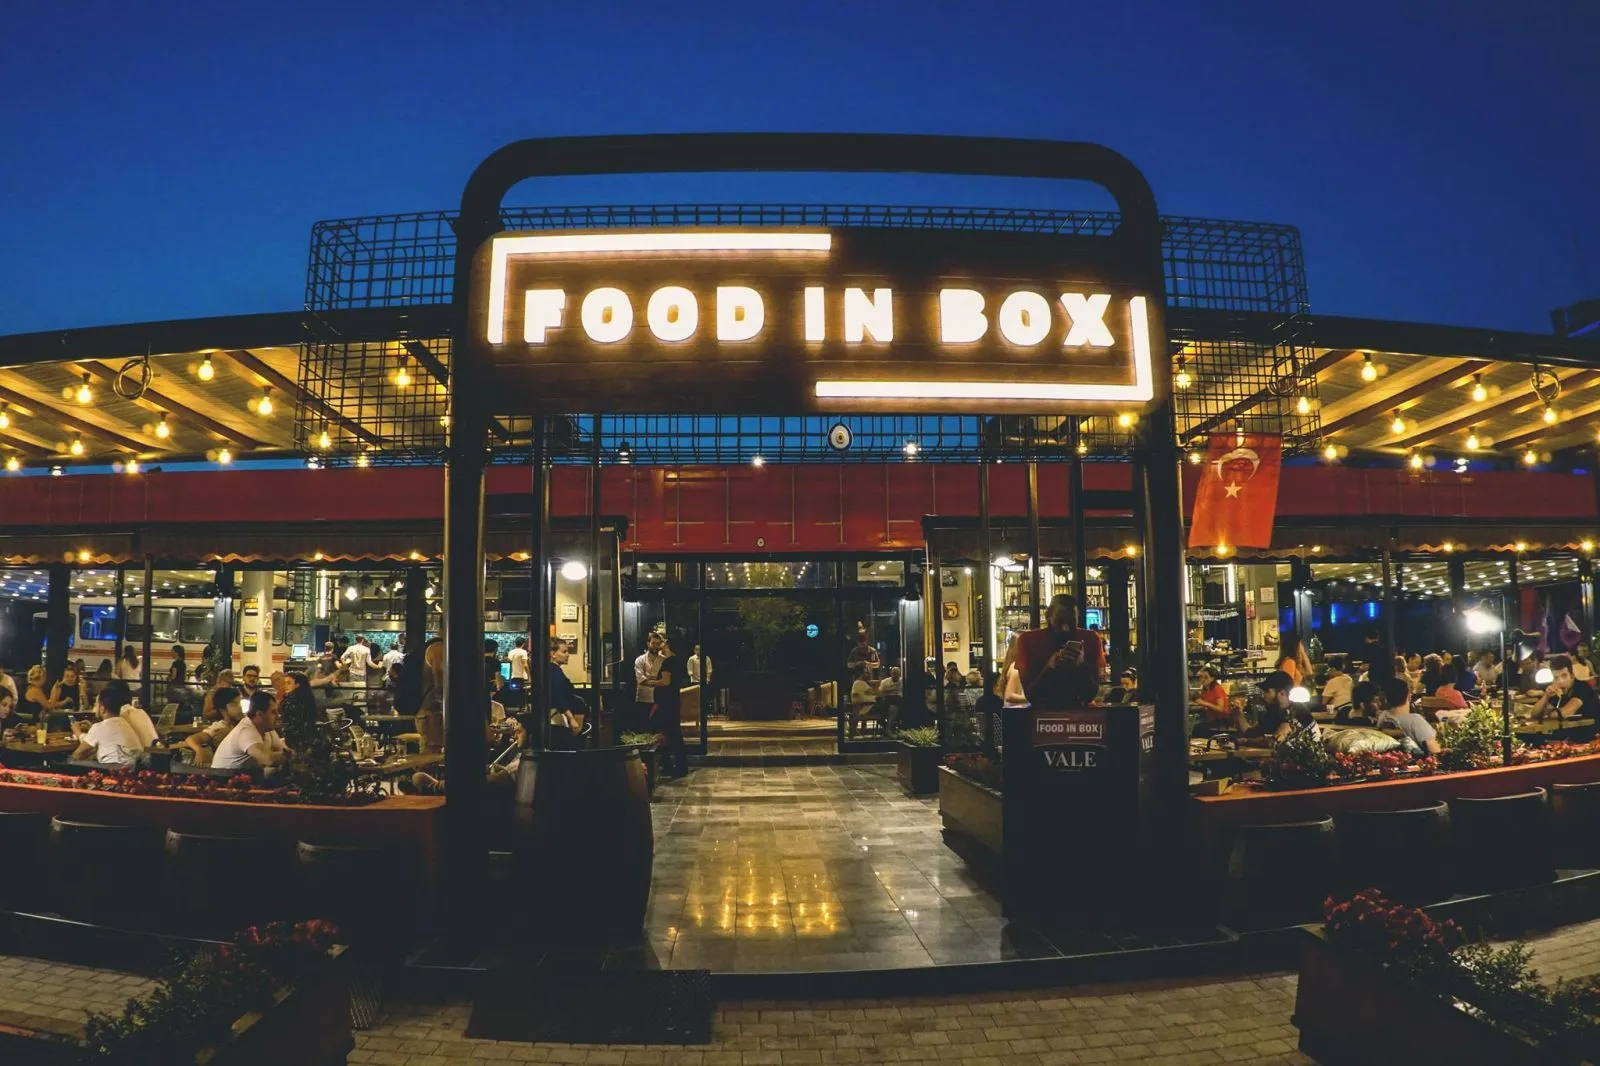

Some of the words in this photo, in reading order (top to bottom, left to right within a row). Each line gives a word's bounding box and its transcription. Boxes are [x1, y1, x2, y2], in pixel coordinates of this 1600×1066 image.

[523, 286, 765, 344] FOOD
[804, 286, 894, 343] IN
[939, 288, 1116, 348] BOX
[1040, 724, 1064, 732] FOOD
[1067, 724, 1076, 732] IN
[1079, 724, 1098, 732] BOX
[1044, 751, 1097, 767] VALE
